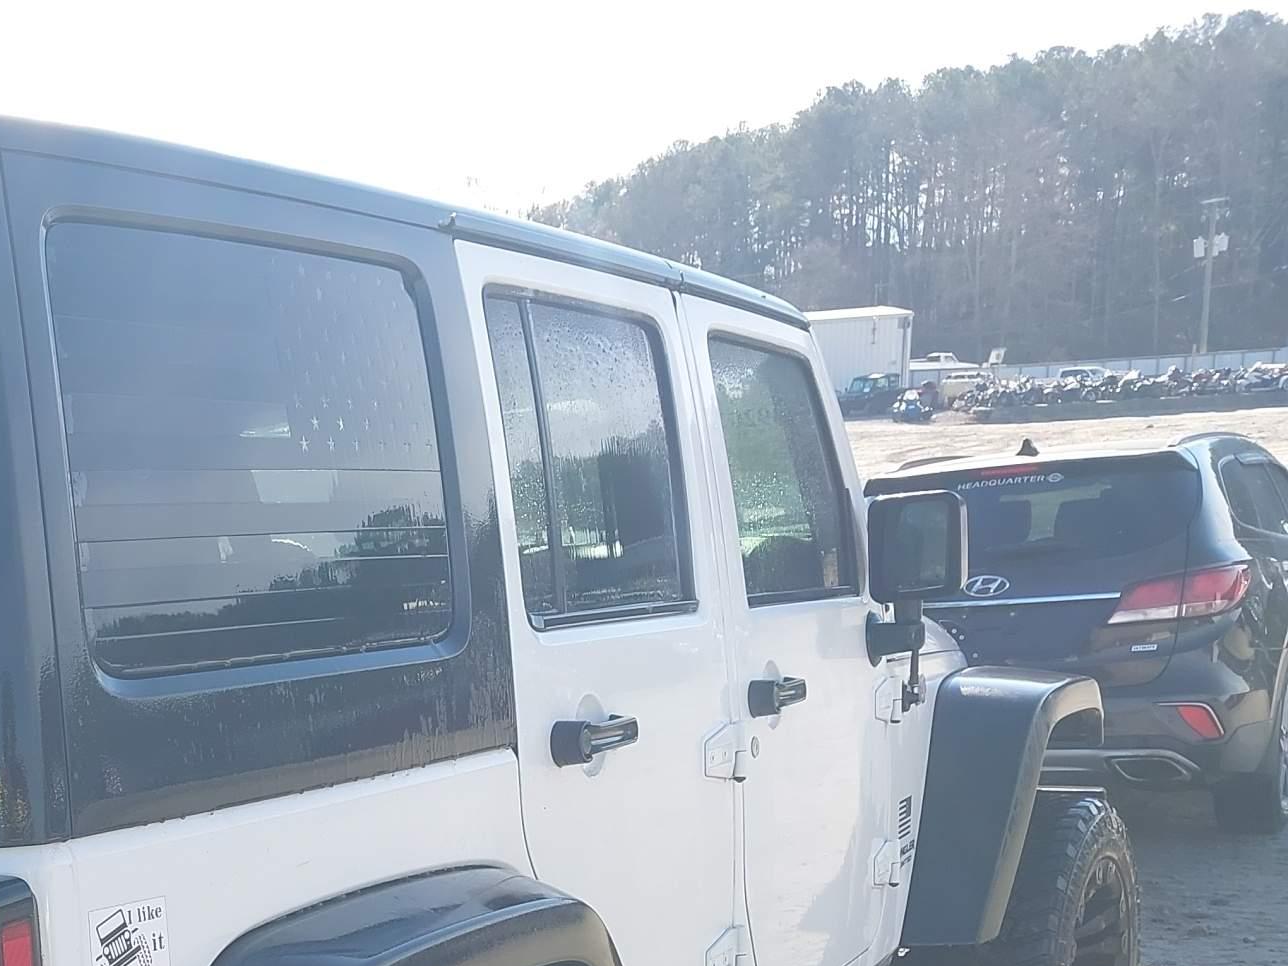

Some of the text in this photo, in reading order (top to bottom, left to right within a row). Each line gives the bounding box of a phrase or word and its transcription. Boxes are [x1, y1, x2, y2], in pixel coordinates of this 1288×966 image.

[957, 474, 1046, 491] HEADQUARTER
[127, 905, 162, 925] I like
[151, 932, 165, 952] it
